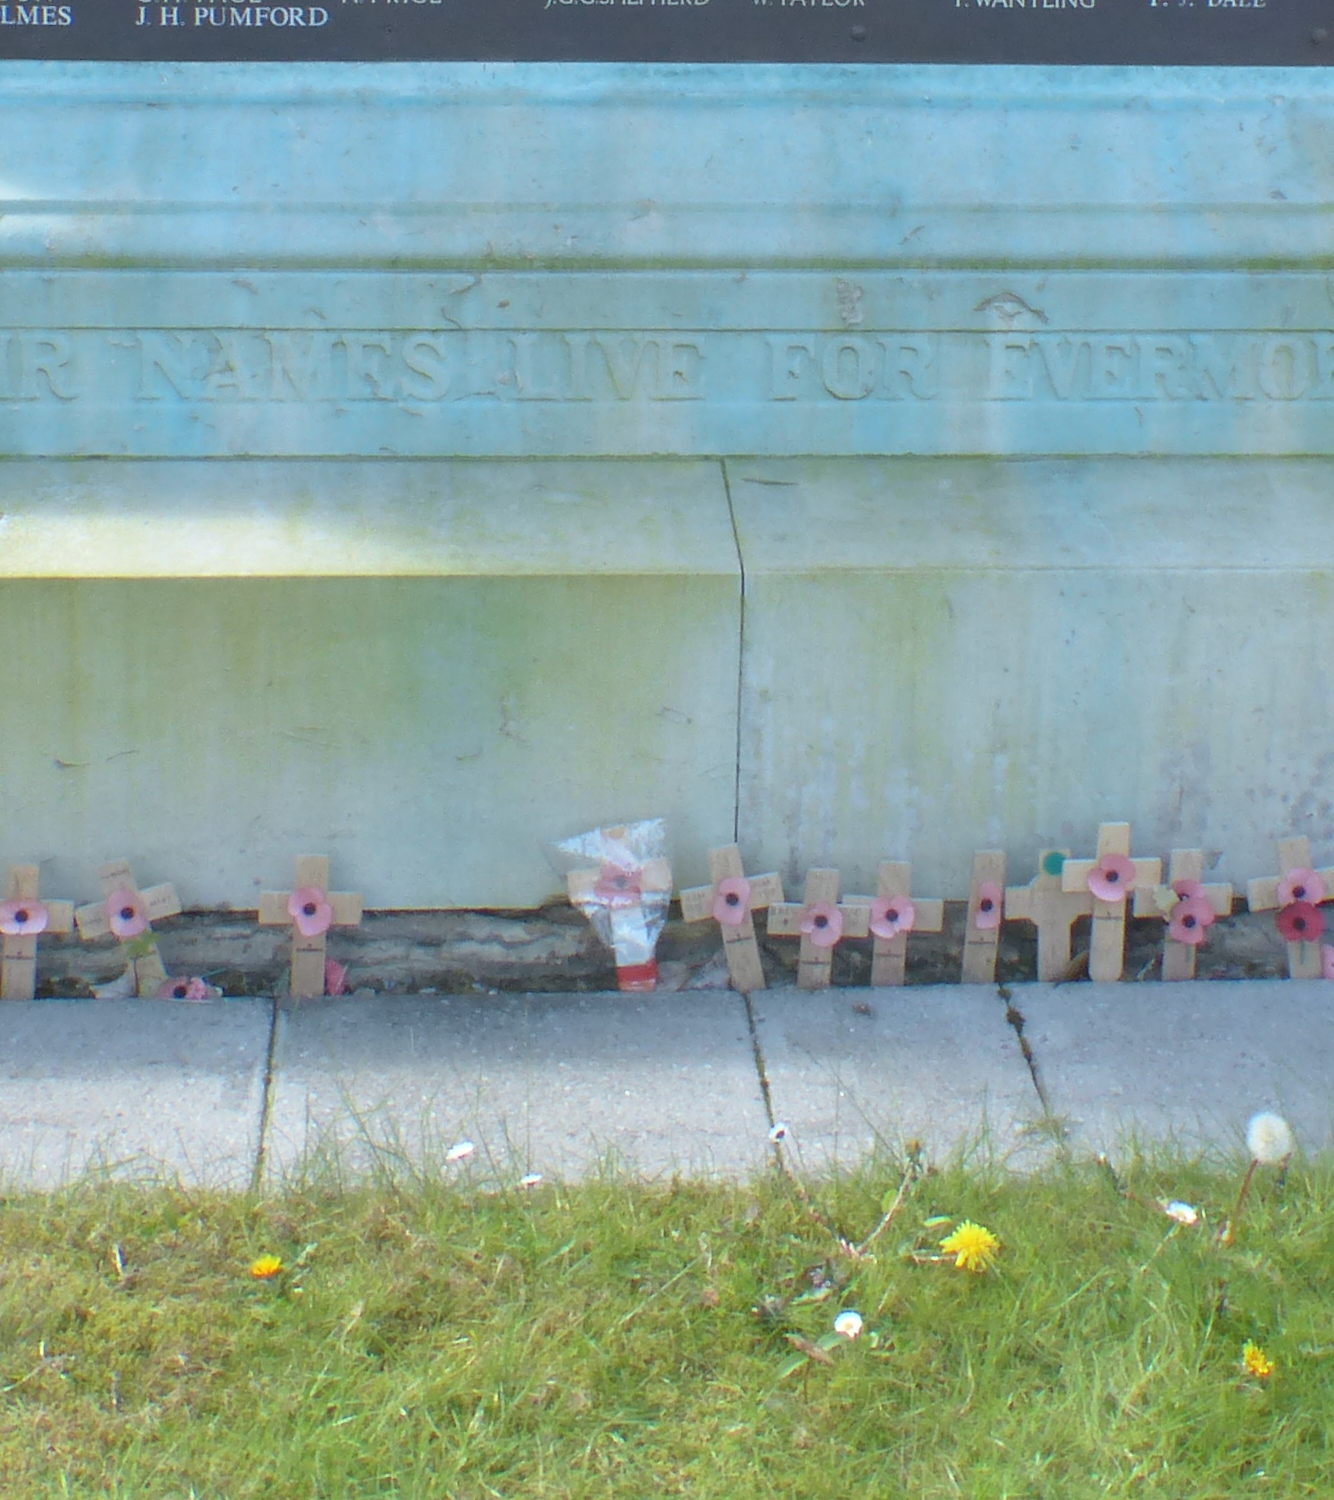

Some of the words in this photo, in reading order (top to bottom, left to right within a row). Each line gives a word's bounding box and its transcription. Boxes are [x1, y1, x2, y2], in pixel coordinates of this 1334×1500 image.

[134, 5, 152, 26] J.
[159, 5, 186, 27] H.
[193, 6, 329, 27] PUMFORD
[129, 330, 453, 402] NAMES
[505, 330, 706, 402] LIVE
[772, 332, 938, 402] FOR
